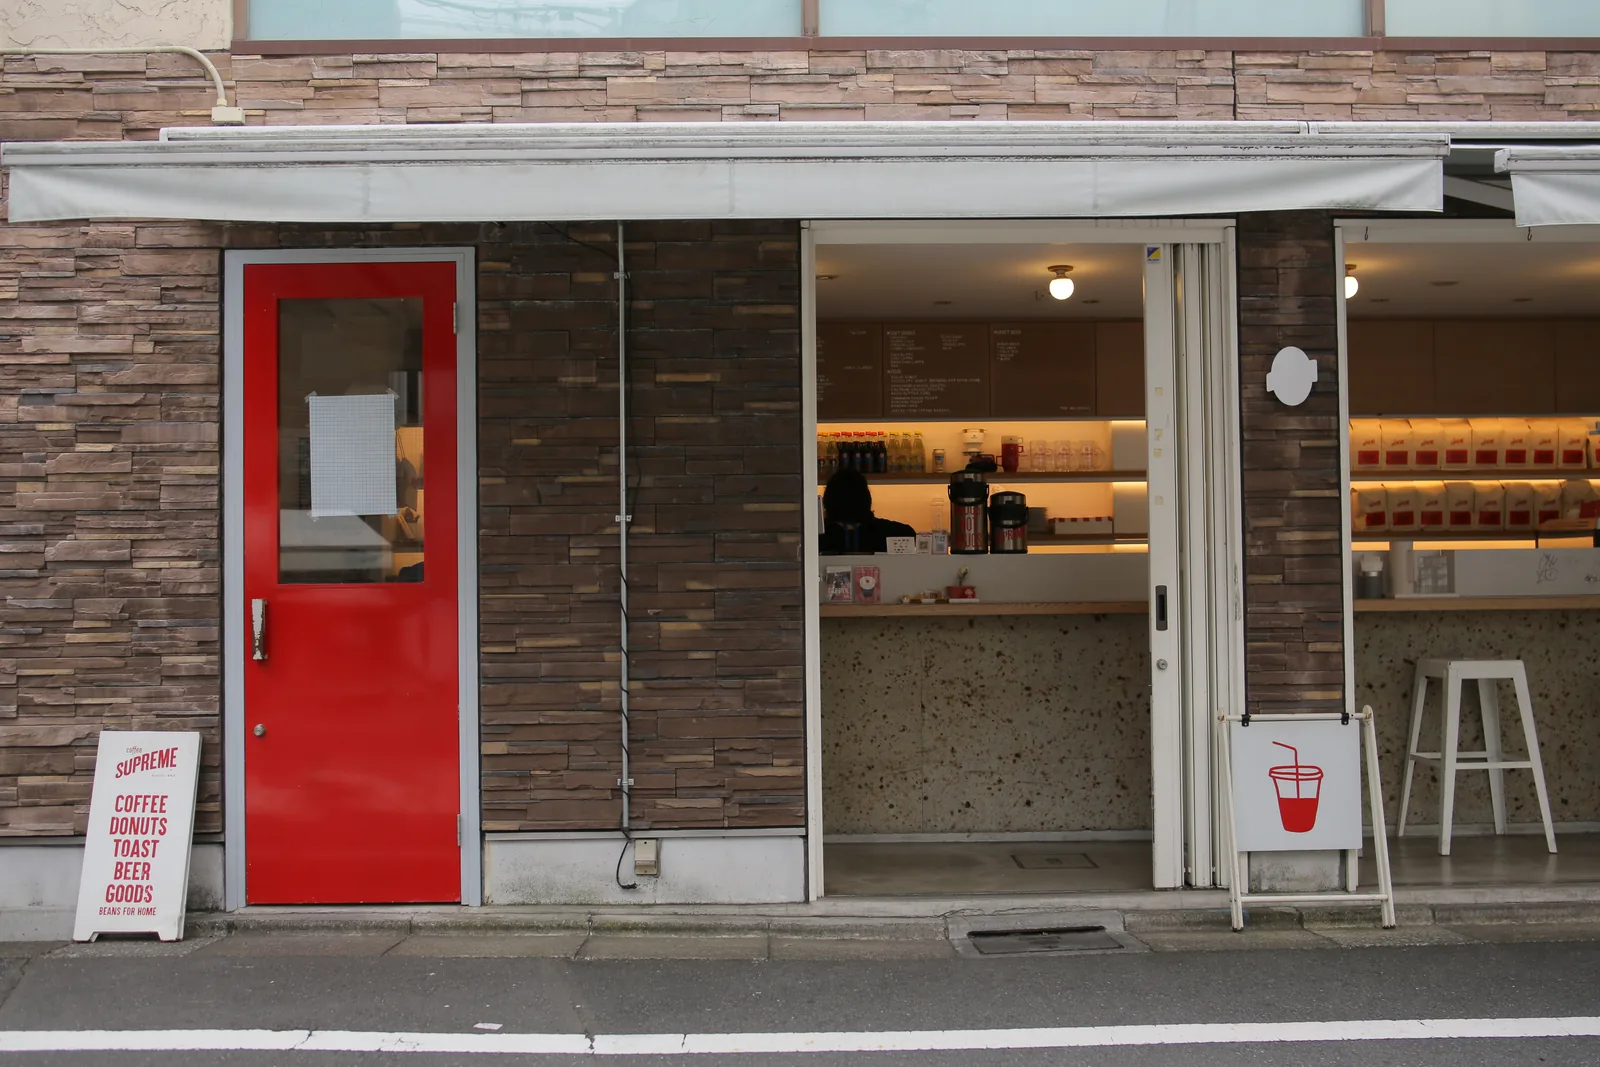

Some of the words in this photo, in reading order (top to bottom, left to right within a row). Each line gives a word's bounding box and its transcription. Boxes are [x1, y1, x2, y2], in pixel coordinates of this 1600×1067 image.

[115, 747, 178, 779] SUPREME
[115, 795, 168, 813] COFFEE
[109, 817, 168, 836] DONUTS
[113, 839, 160, 858] TOAST
[113, 861, 151, 880] BEER
[105, 884, 153, 903] GOODS
[98, 907, 121, 916] BEANS
[123, 907, 135, 916] FOR
[137, 907, 157, 916] HOME
